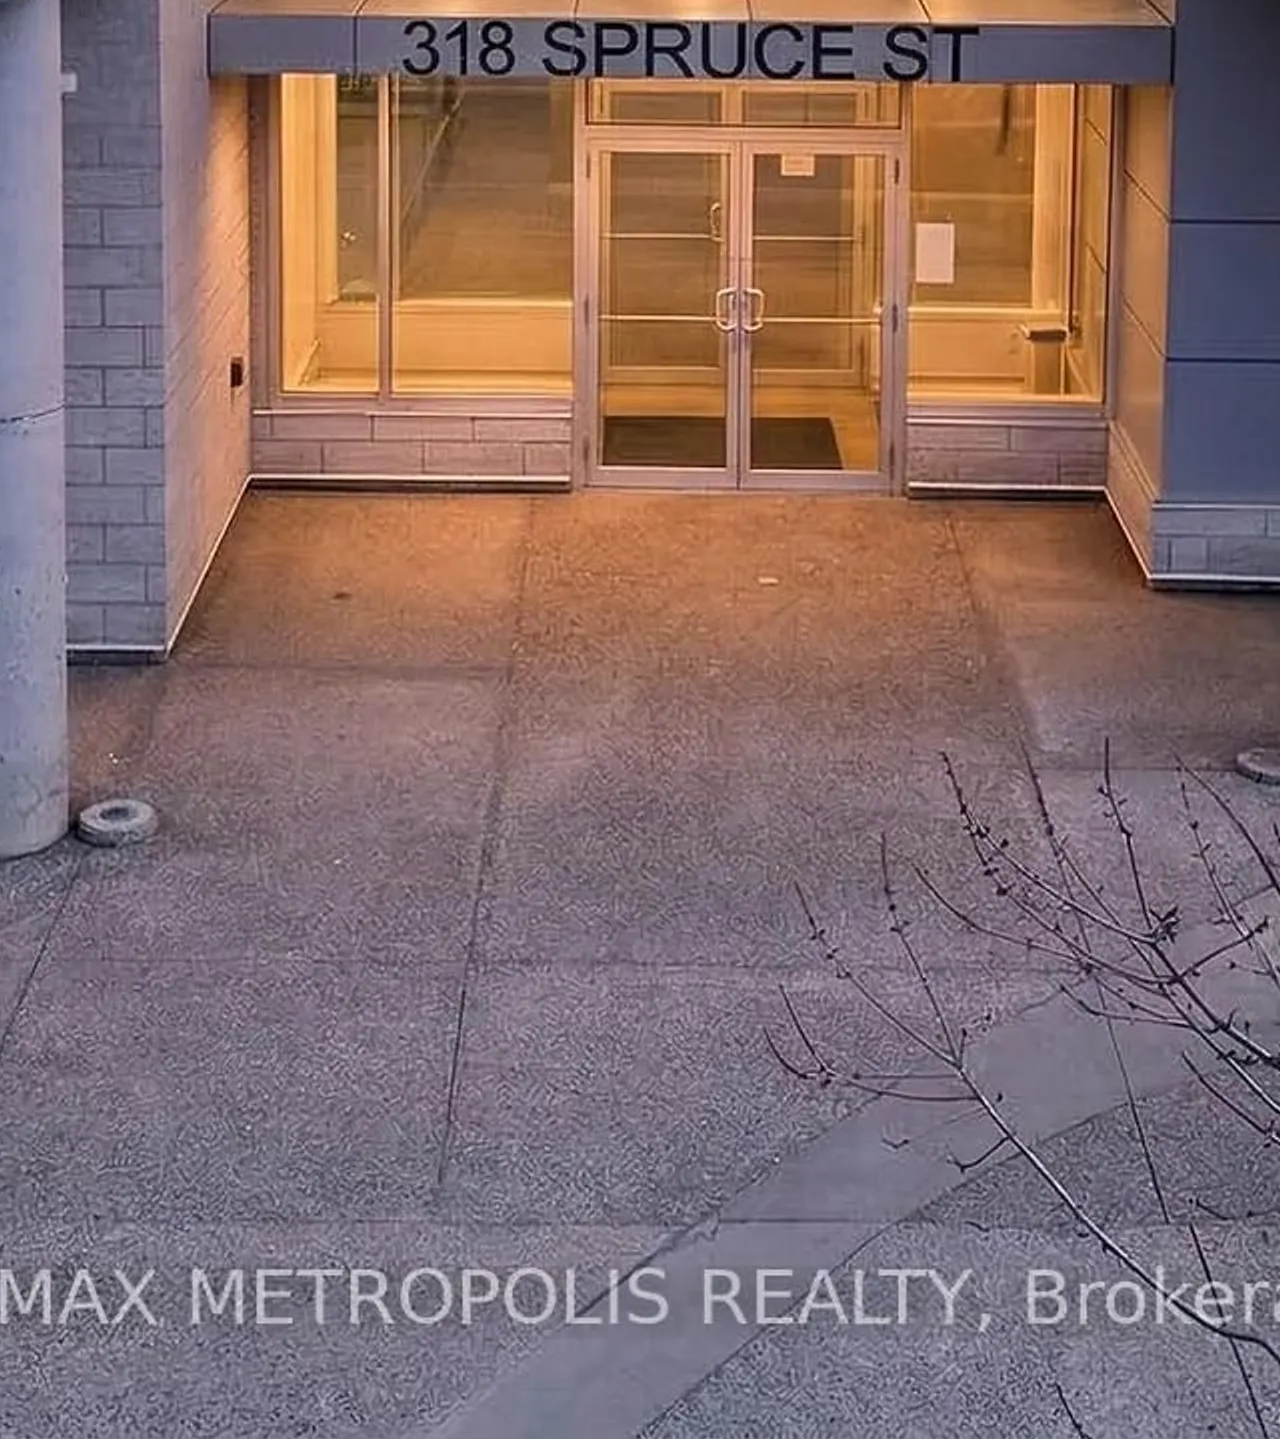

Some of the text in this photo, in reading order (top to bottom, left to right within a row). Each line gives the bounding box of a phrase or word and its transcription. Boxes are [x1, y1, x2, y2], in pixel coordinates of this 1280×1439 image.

[401, 20, 980, 81] 318 SPRUCE ST
